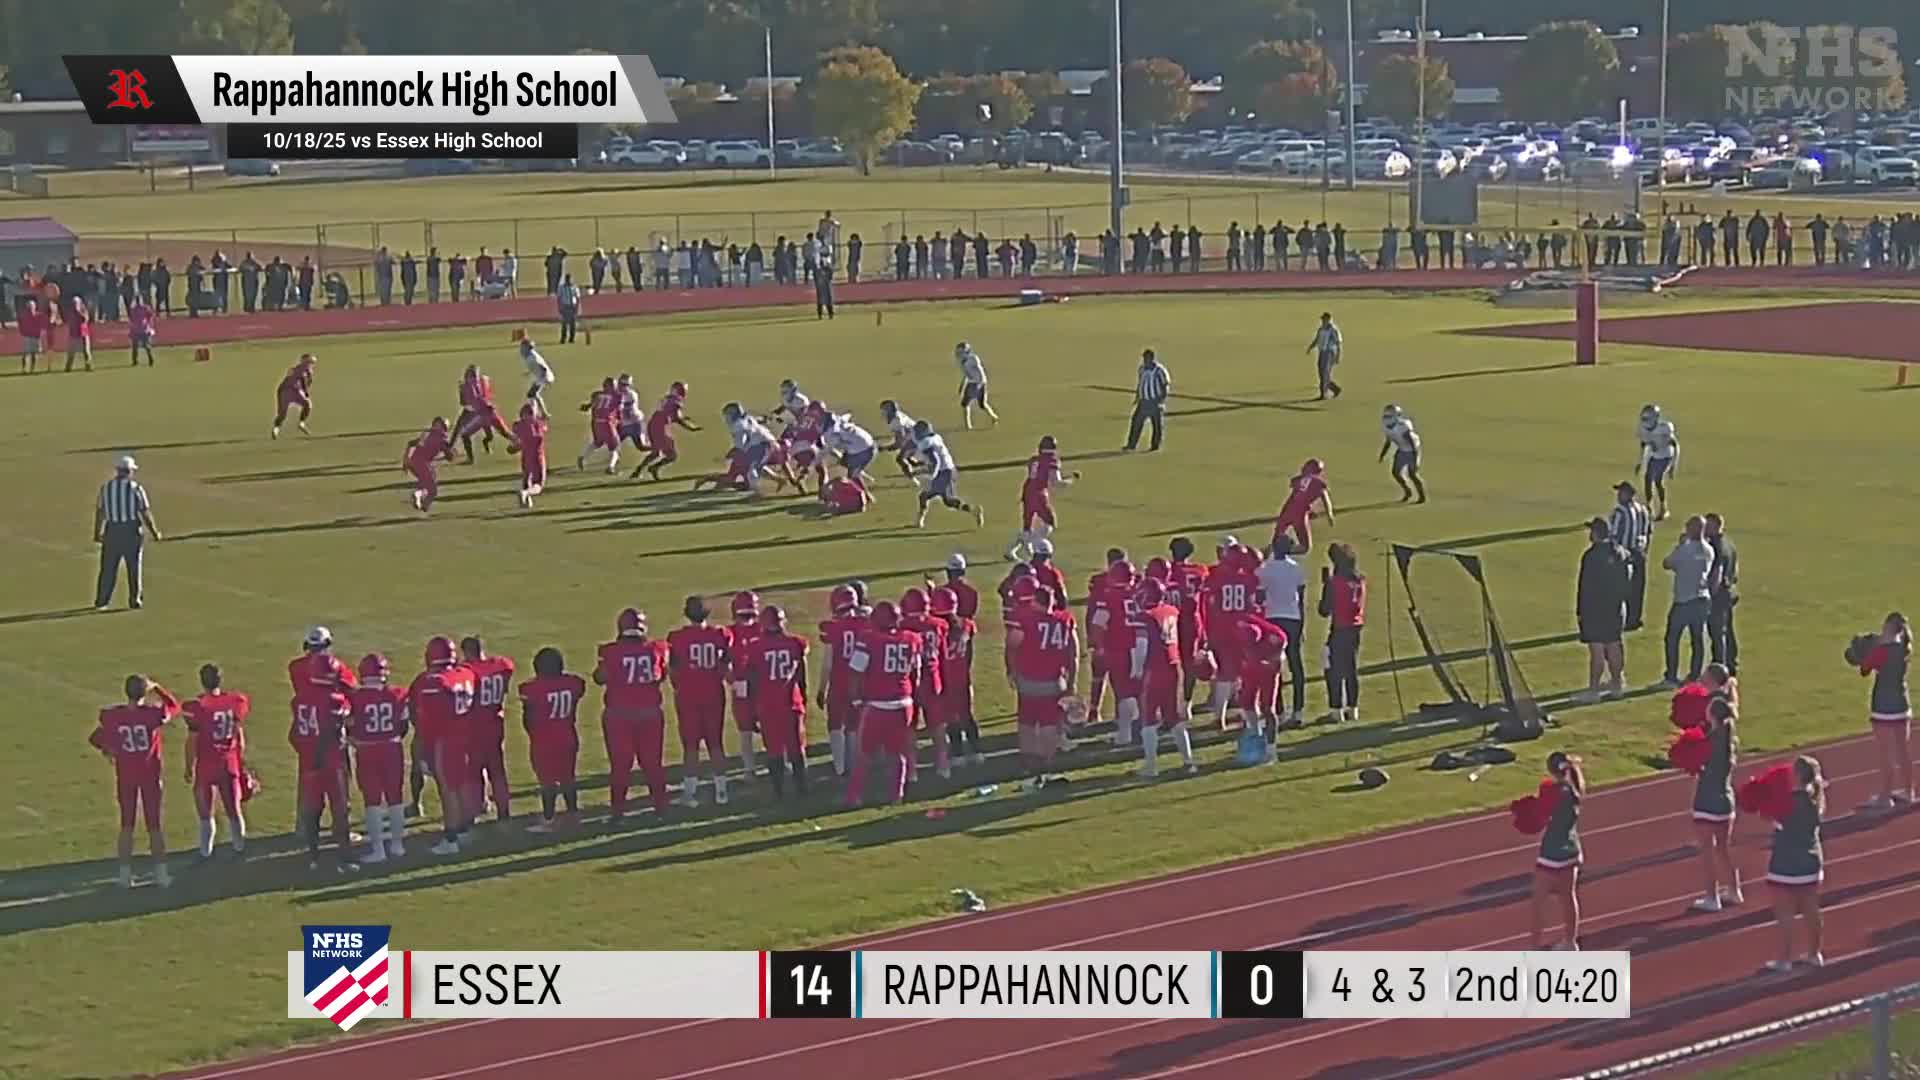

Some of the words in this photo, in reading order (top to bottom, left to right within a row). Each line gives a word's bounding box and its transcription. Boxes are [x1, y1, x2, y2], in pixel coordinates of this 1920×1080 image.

[1222, 584, 1246, 611] 88
[1038, 622, 1063, 650] 74
[623, 655, 653, 684] 73
[690, 642, 715, 669] 90
[764, 650, 793, 681] 72
[884, 643, 910, 673] 65
[481, 674, 504, 706] 60
[547, 690, 572, 719] 70
[213, 710, 234, 740] 31
[298, 704, 320, 736] 54
[365, 702, 394, 733] 32
[118, 724, 150, 752] 33
